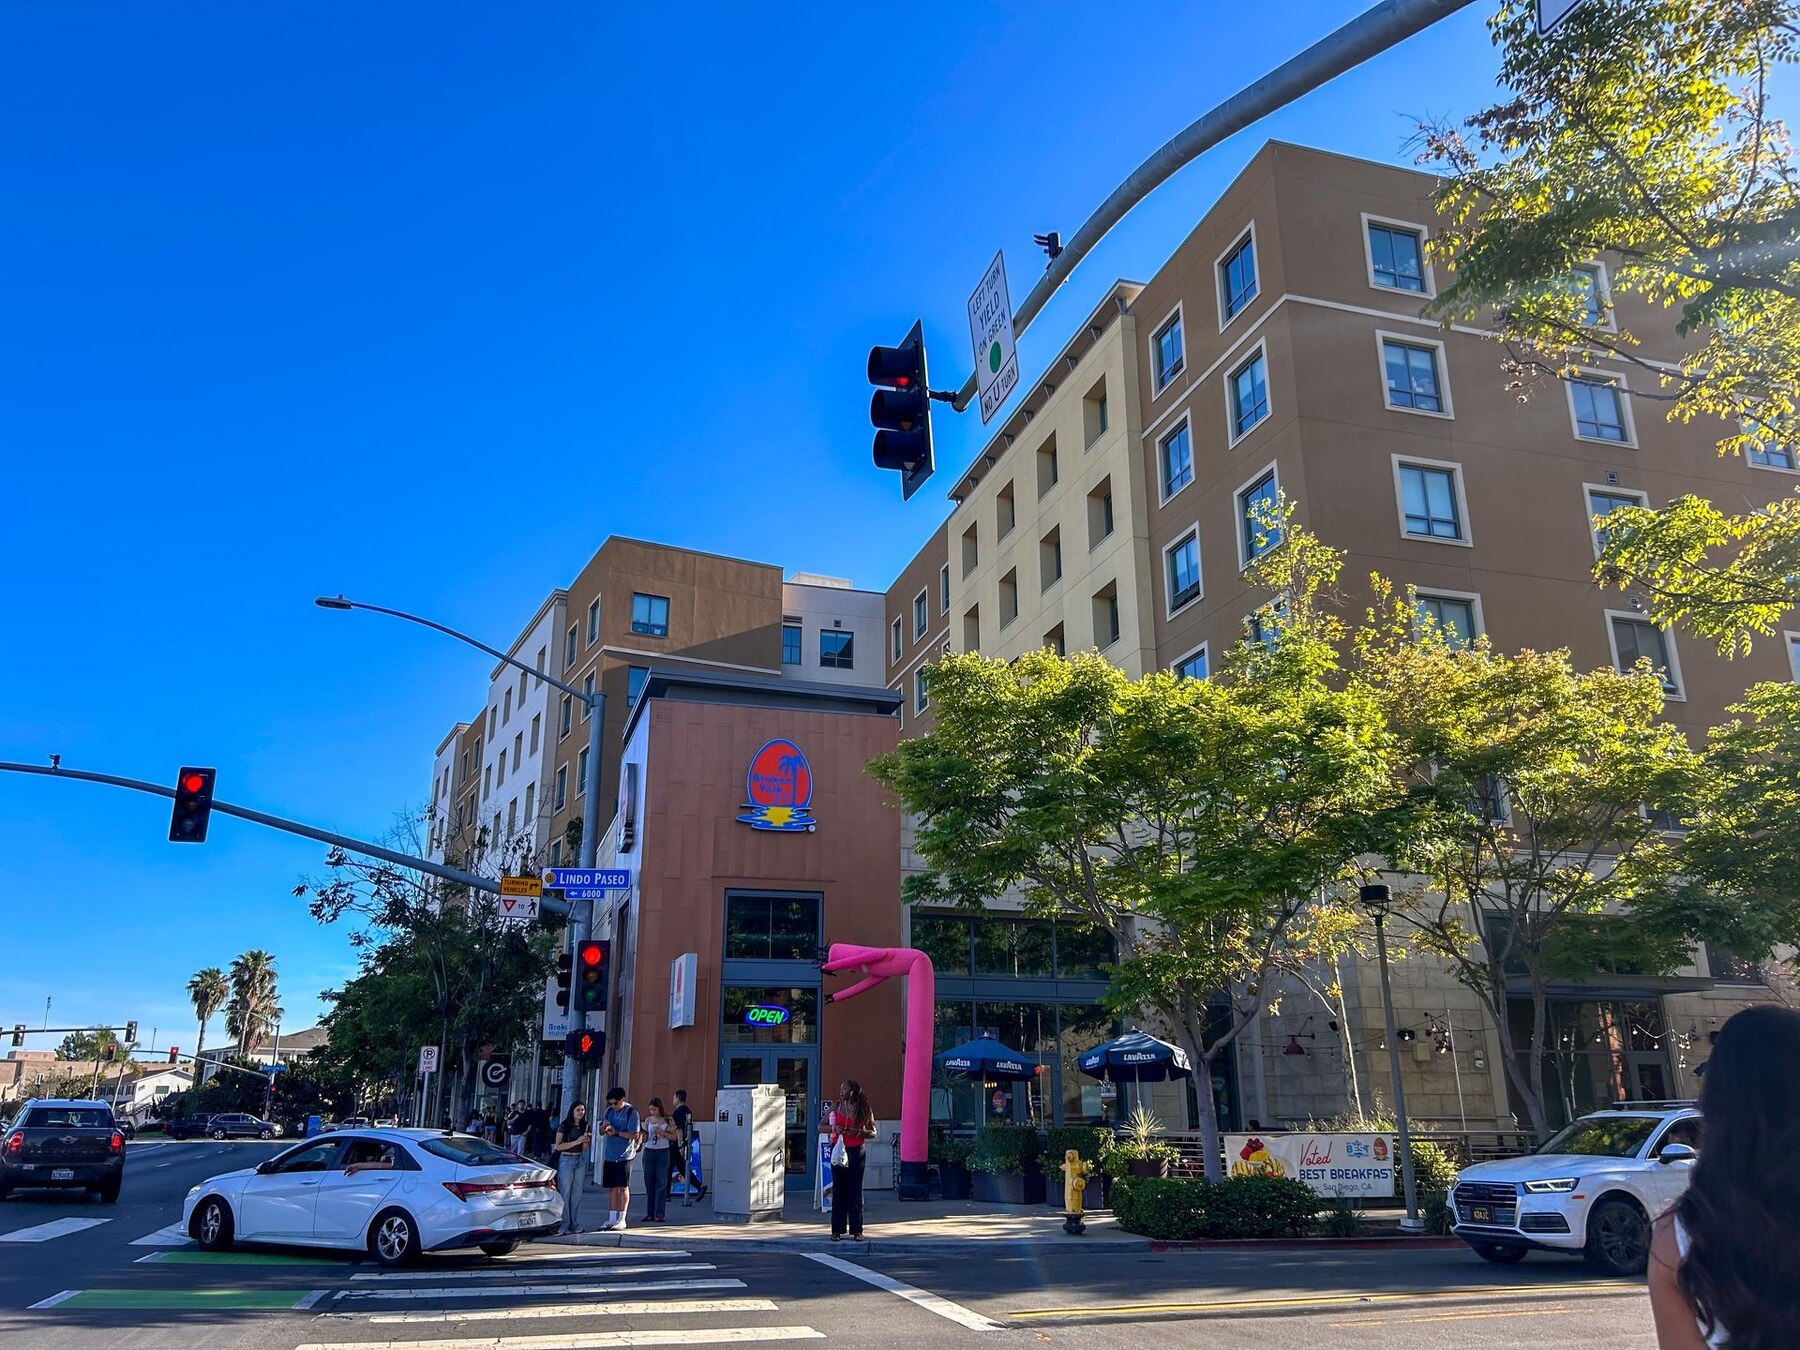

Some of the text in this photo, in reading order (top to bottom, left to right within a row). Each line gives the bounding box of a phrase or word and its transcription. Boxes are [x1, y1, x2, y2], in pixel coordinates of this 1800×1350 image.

[972, 267, 1001, 316] LEFT TURN
[978, 291, 1000, 331] YIELD
[978, 308, 1006, 356] ON GREEN
[984, 364, 1016, 415] NO U TURN
[559, 872, 625, 885] LINDO PASEO
[581, 889, 601, 898] 6000
[748, 1008, 785, 1024] OPEN
[1123, 1052, 1156, 1061] LAVAZZA
[1300, 1140, 1332, 1166] Voted
[1299, 1168, 1326, 1180] BEST
[1323, 1183, 1336, 1191] San
[1361, 1183, 1373, 1191] CA
